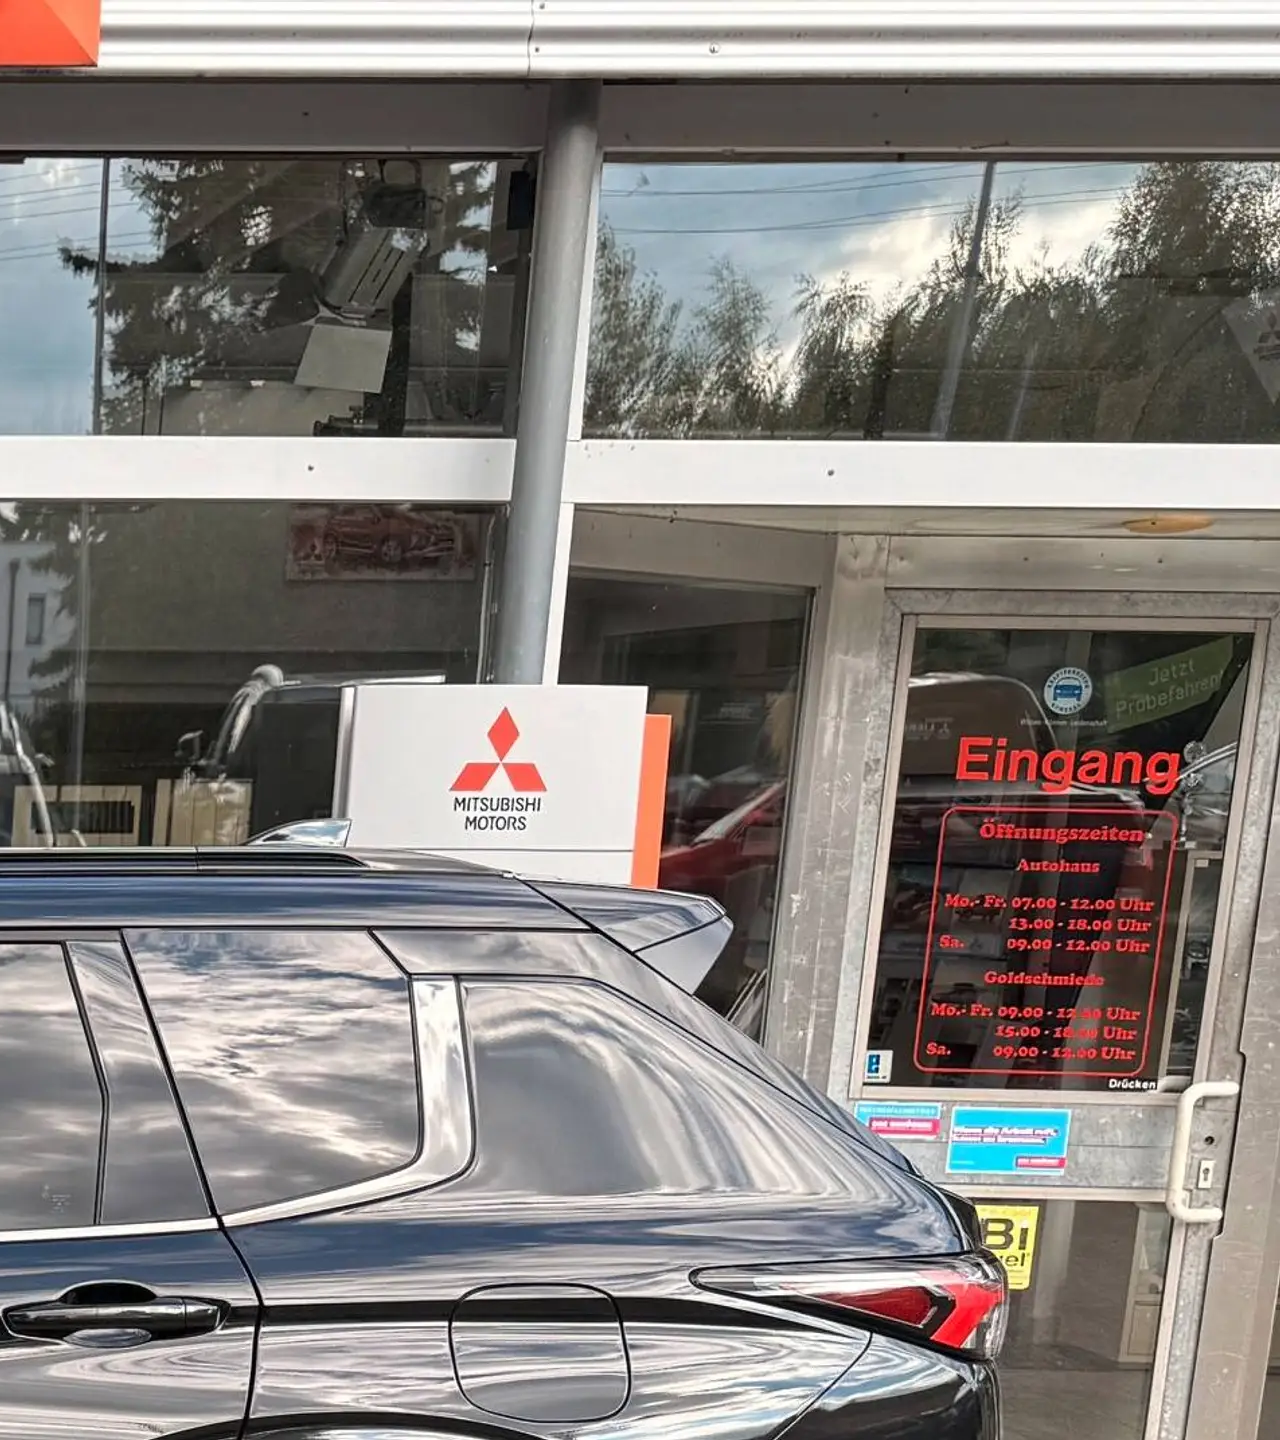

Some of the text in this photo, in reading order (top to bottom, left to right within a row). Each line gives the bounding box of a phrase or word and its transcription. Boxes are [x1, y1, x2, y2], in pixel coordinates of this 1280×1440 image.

[1148, 659, 1194, 686] Jetzt
[955, 736, 1181, 795] Eingang
[453, 797, 541, 812] MITSUBISHI
[464, 815, 527, 831] MOTORS
[979, 818, 1145, 844] Öffnungszeiten
[1016, 858, 1100, 873] Autohaus
[983, 895, 1007, 908] Fr.
[1011, 896, 1057, 911] 07.00
[1070, 898, 1115, 911] 12.00
[1119, 898, 1154, 912] Uhr
[1008, 917, 1054, 931] 13.00
[1067, 918, 1112, 931] 18.00
[1117, 918, 1151, 932] Uhr
[939, 935, 965, 948] Sa.
[1007, 938, 1052, 951] 09.00
[1066, 939, 1111, 951] 12.00
[1116, 938, 1150, 953] Uhr
[984, 971, 1105, 986] Goldschmiede
[970, 1004, 993, 1017] Fr.
[998, 1007, 1043, 1020] 09.00
[1106, 1007, 1141, 1021] Uhr
[995, 1025, 1040, 1038] 15.00
[1103, 1026, 1137, 1040] Uhr
[926, 1042, 951, 1056] Sa.
[993, 1046, 1038, 1058] 09.00
[1101, 1045, 1136, 1060] Uhr
[1108, 1078, 1156, 1090] Drücken
